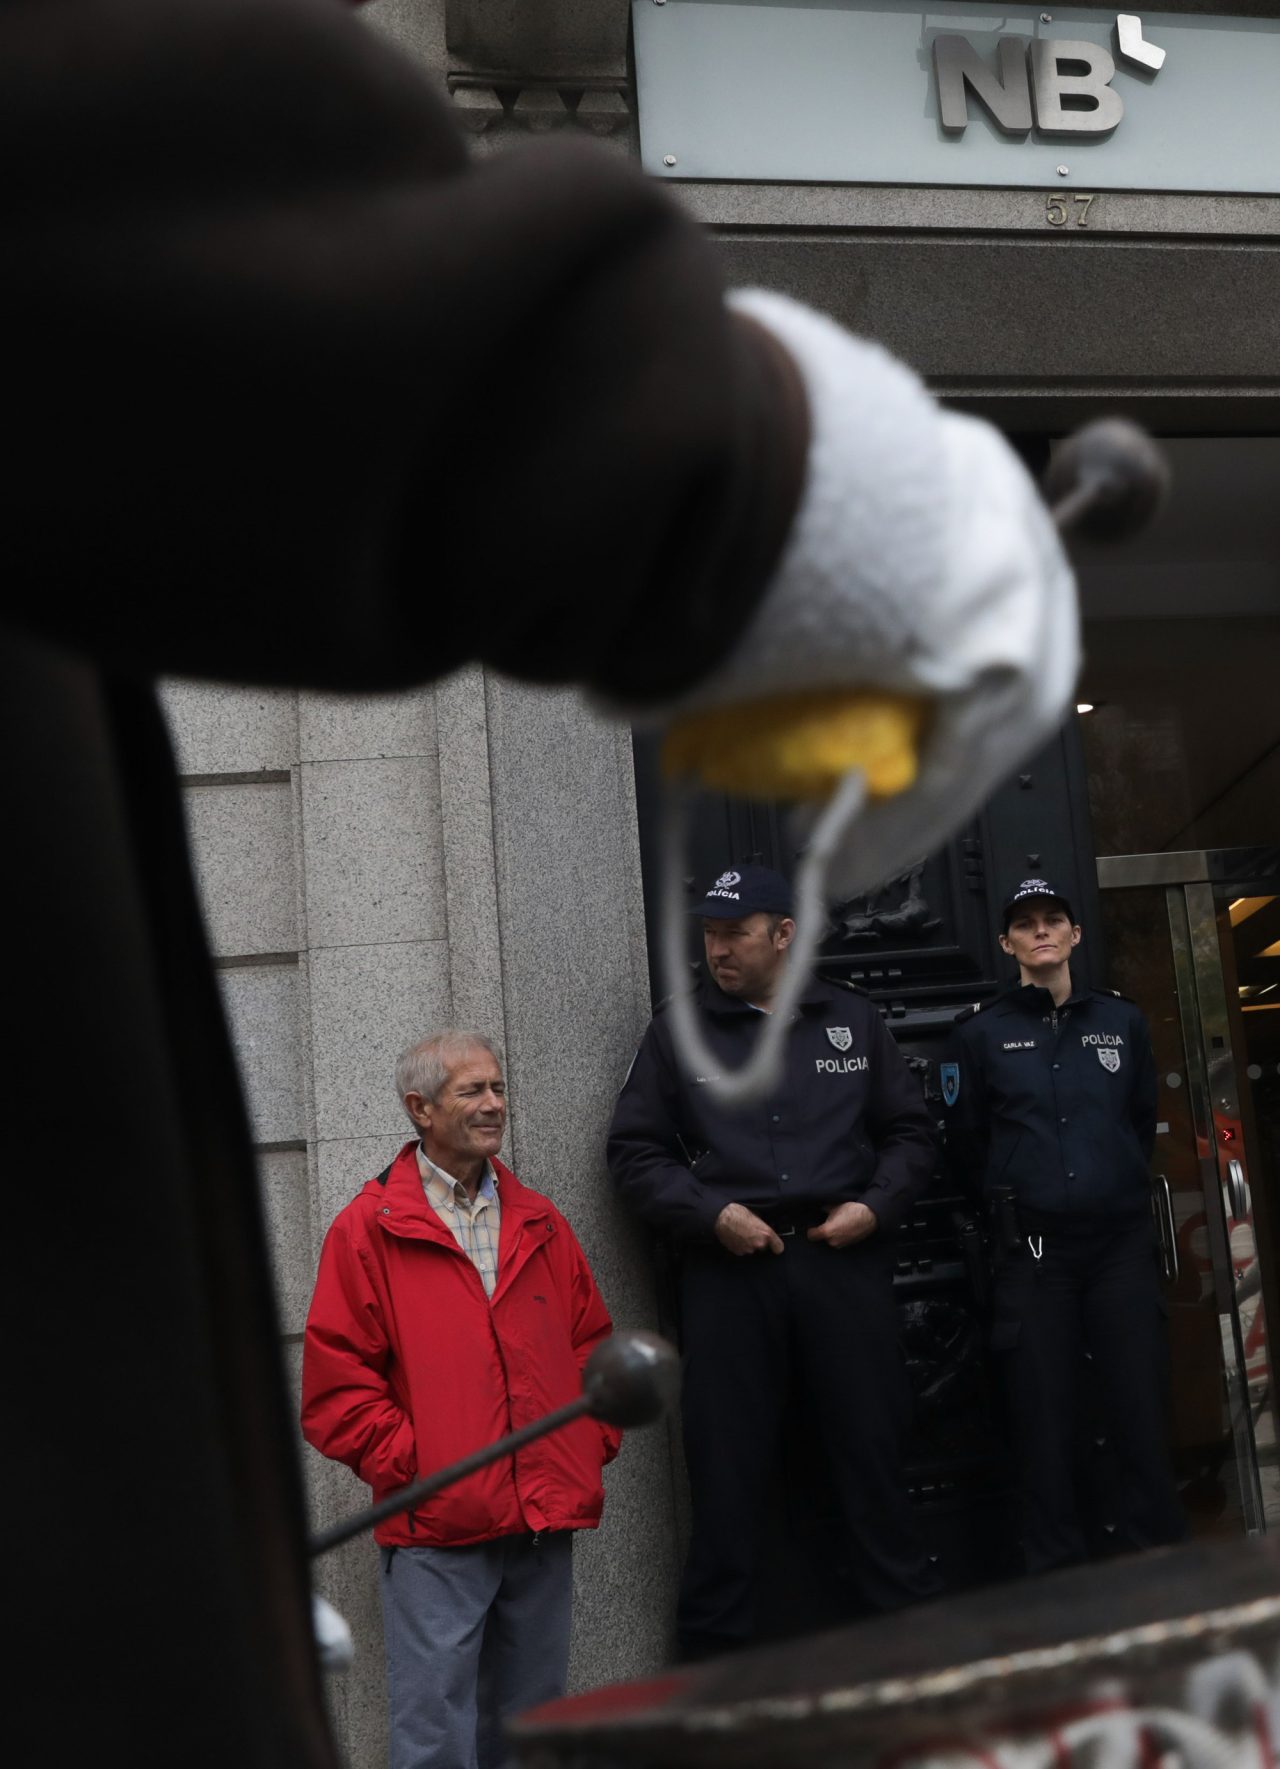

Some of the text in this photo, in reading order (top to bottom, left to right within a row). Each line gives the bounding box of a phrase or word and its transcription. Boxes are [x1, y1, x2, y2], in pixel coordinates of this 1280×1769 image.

[1046, 196, 1094, 227] 57
[1081, 1032, 1124, 1047] POLÍCIA
[816, 1057, 869, 1073] POLÍCIA
